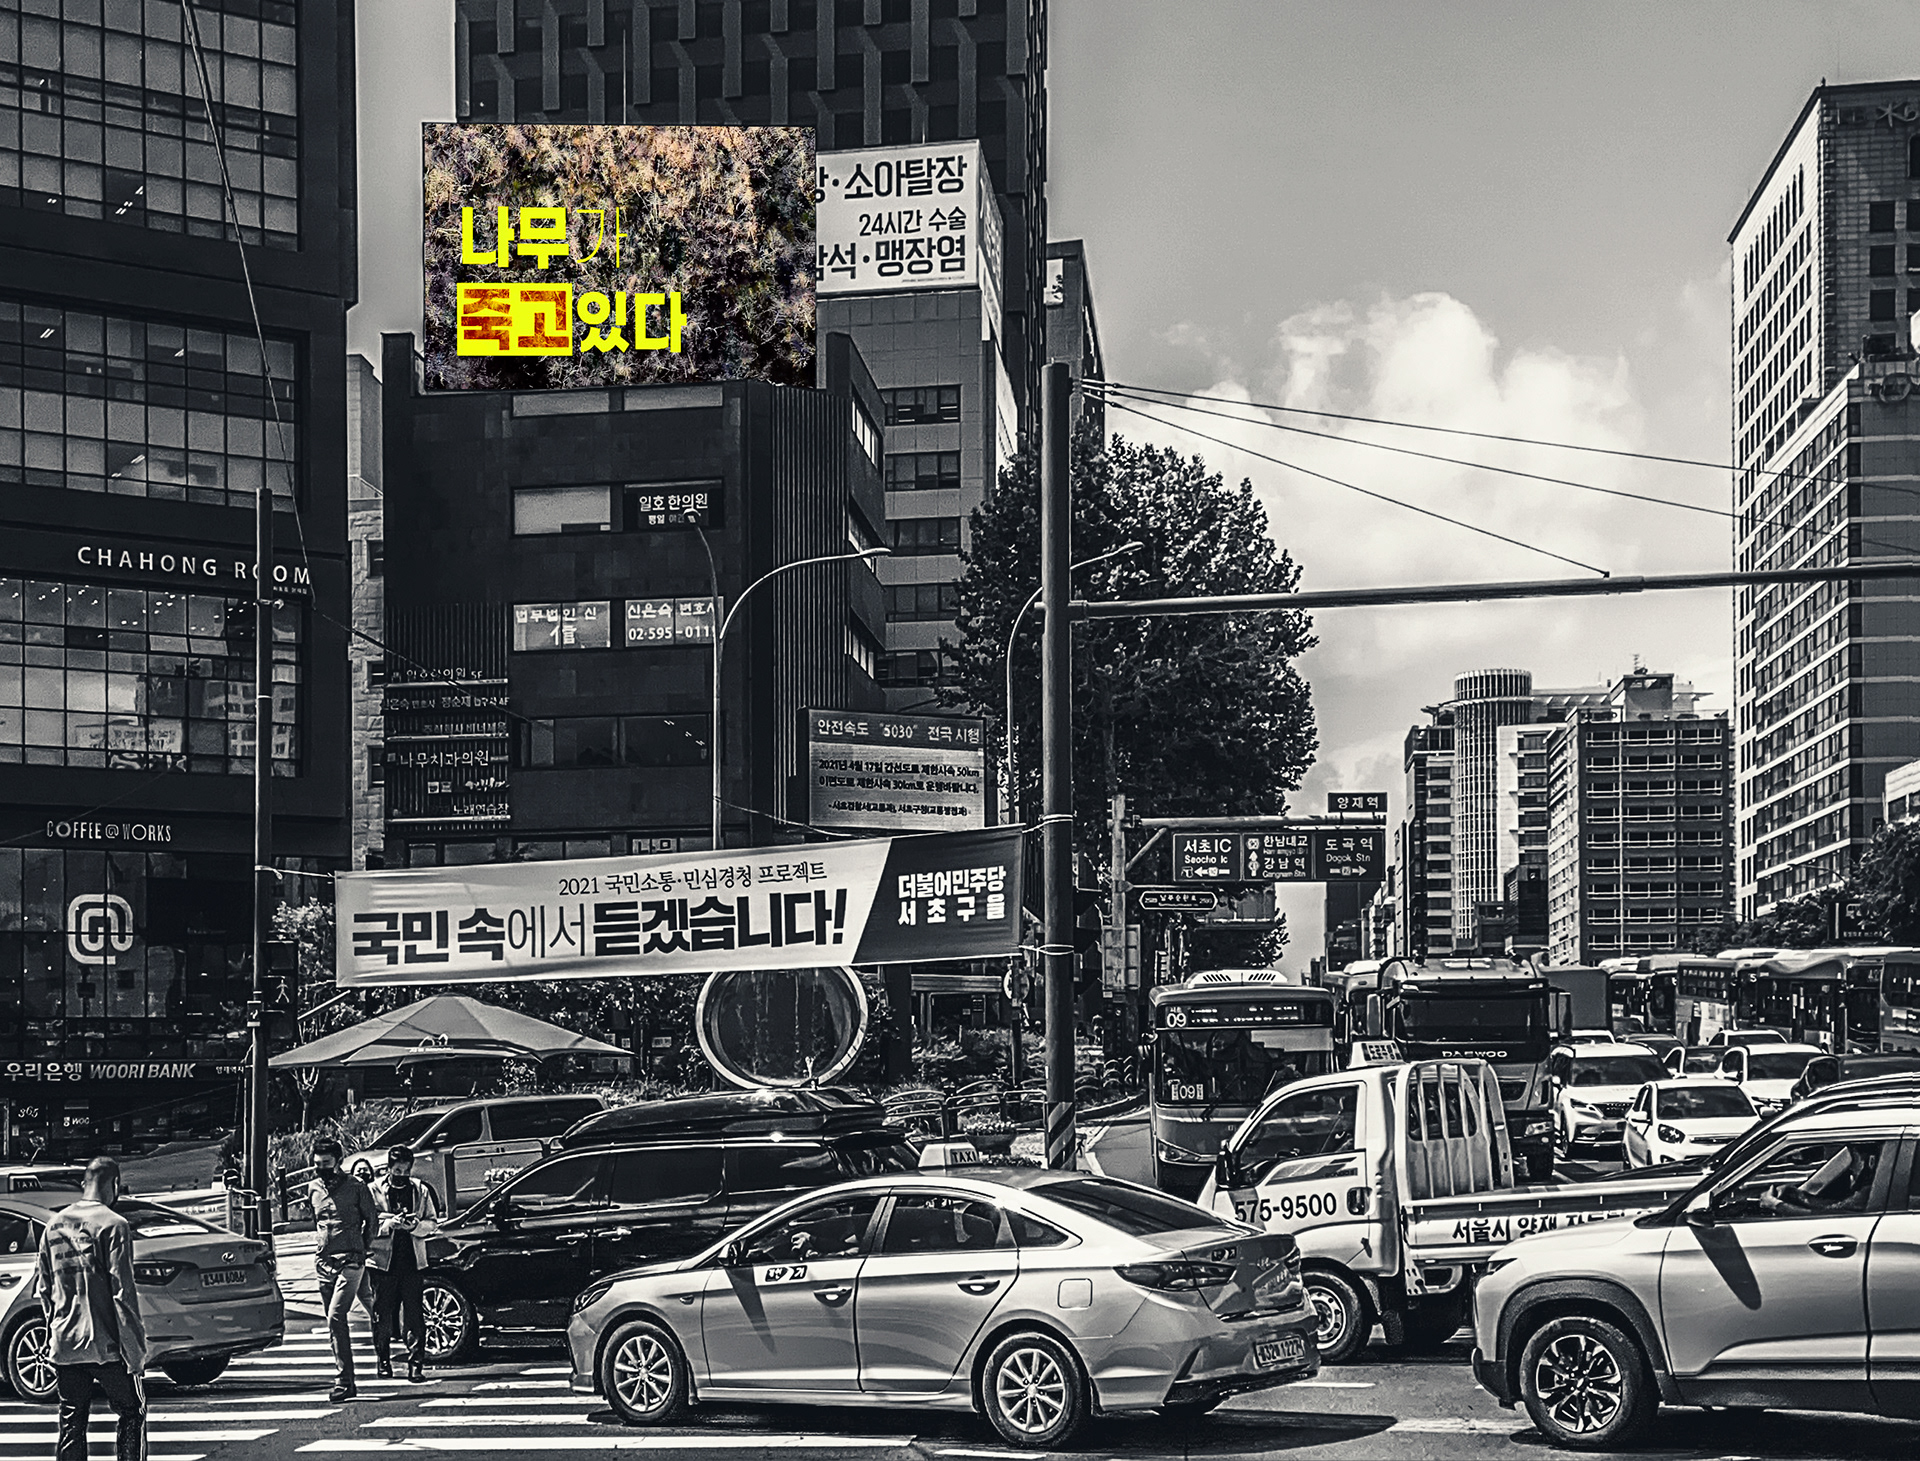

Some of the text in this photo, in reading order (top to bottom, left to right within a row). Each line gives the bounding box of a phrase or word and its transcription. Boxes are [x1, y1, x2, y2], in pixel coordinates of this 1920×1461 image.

[859, 206, 967, 236] 24시간 수술
[461, 206, 628, 269] 나무가
[639, 493, 708, 512] 일호 한의원
[78, 546, 217, 576] CHAHONG
[516, 607, 597, 623] 법무법인 신
[628, 603, 672, 619] 신은숙
[818, 719, 869, 737] 안전속도
[927, 726, 953, 742] 전국
[955, 728, 980, 744] 시행
[400, 750, 489, 768] 나무치과의원
[1337, 796, 1379, 809] 양재역
[1263, 835, 1309, 847] 한남대교
[1325, 837, 1373, 851] 도곡역
[1263, 857, 1306, 869] 강남역
[559, 861, 828, 895] 2021 국민소통·민심경청 프로젝트
[898, 865, 1007, 899] 더불어민주당
[353, 888, 848, 965] 국민 속에서 듣겠습니다!
[1167, 1012, 1187, 1028] 09
[1442, 1050, 1508, 1058] DAEWOO
[4, 1062, 197, 1081] 우리은행 WOORI BANK
[1179, 1085, 1196, 1099] 09
[18, 1106, 40, 1118] 365
[952, 1151, 978, 1164] TAXI
[1235, 1192, 1337, 1223] 575-9500
[1452, 1216, 1510, 1243] 서울시
